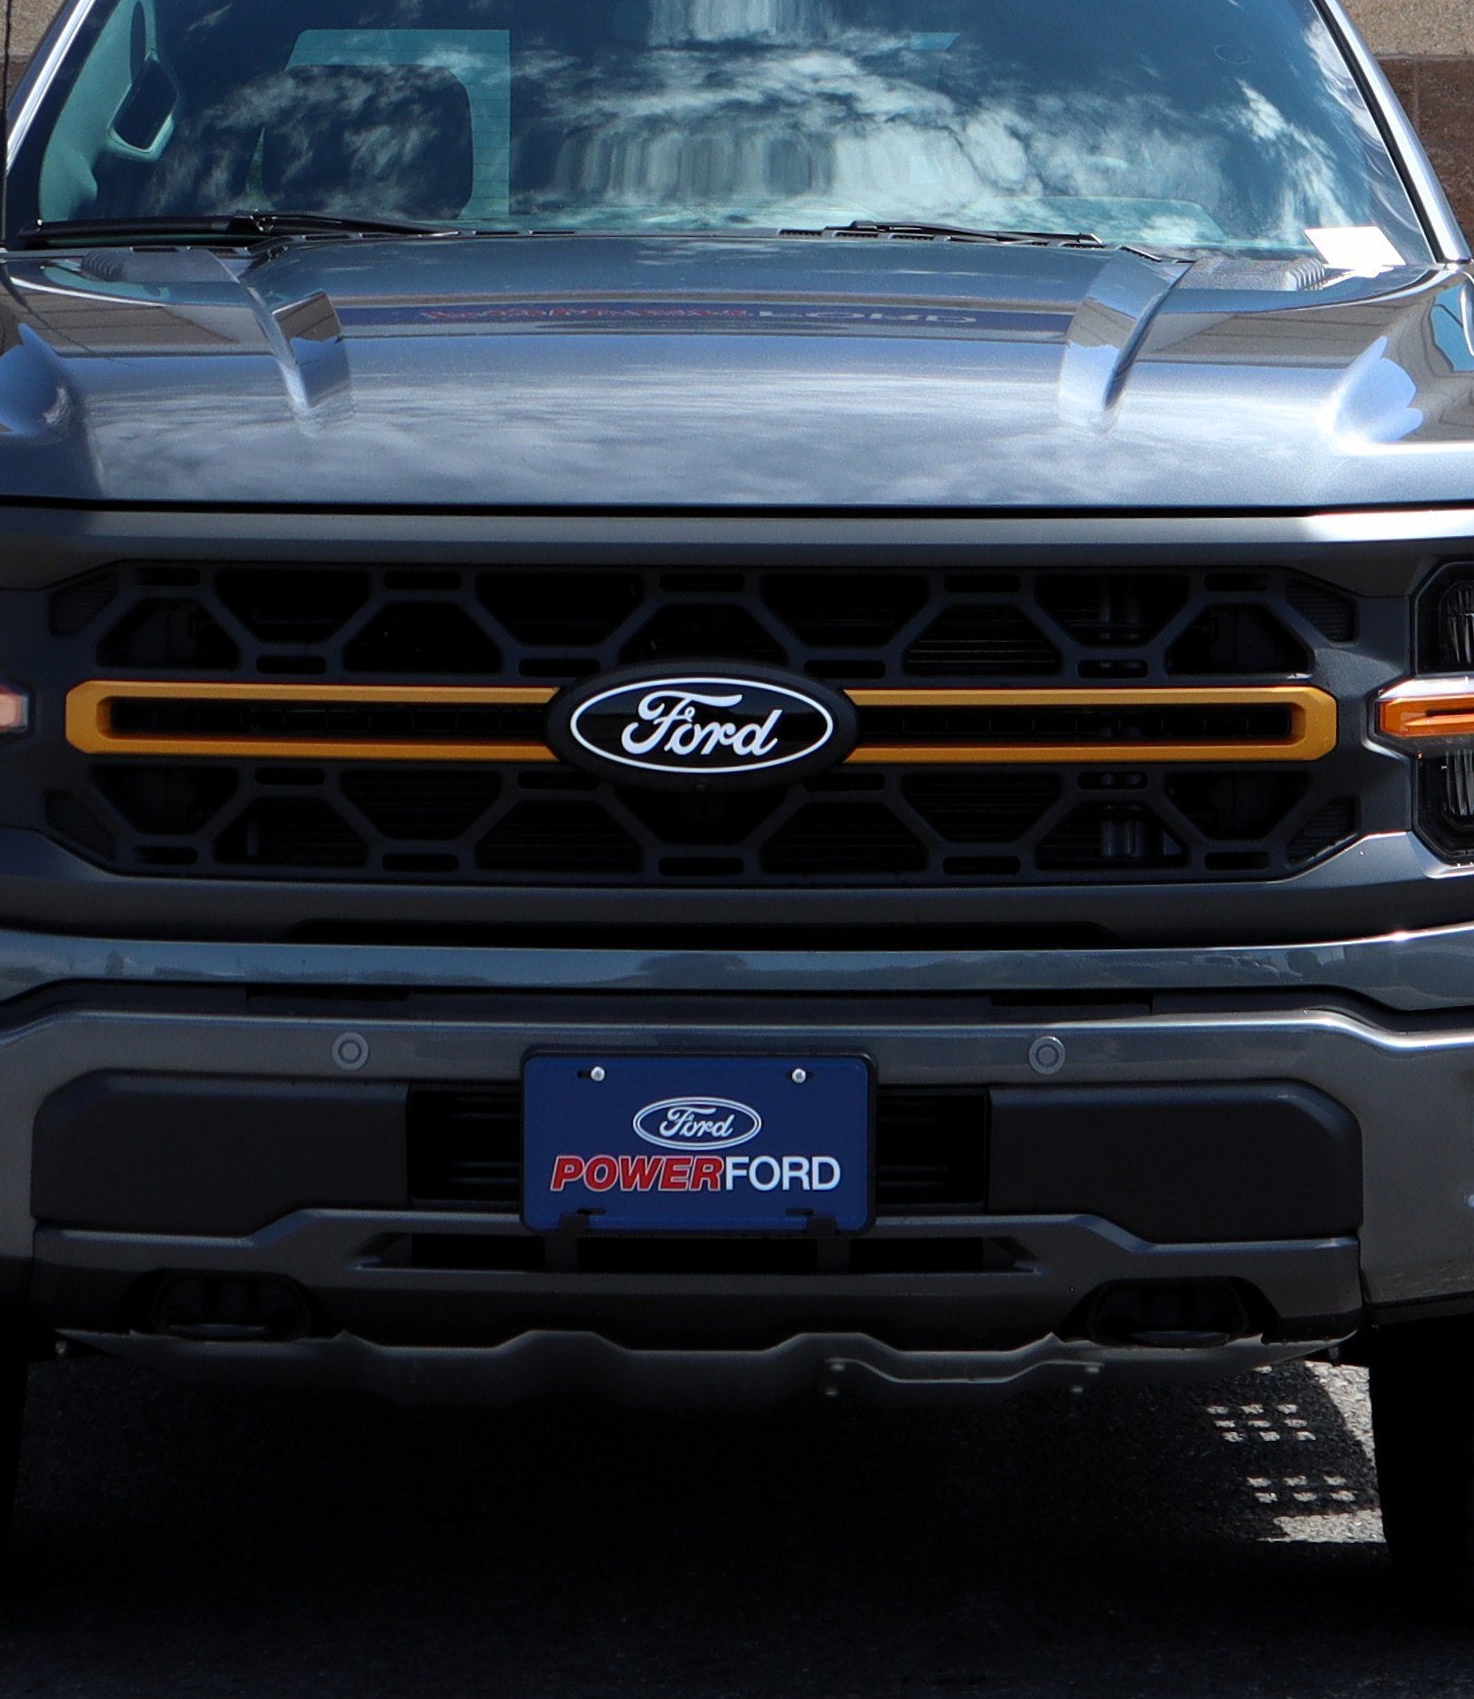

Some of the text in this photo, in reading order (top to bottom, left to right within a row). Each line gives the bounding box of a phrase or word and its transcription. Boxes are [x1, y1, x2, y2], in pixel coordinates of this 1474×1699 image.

[621, 690, 783, 757] Ford
[659, 1106, 734, 1139] Ford
[550, 1154, 842, 1193] POWERFORD
